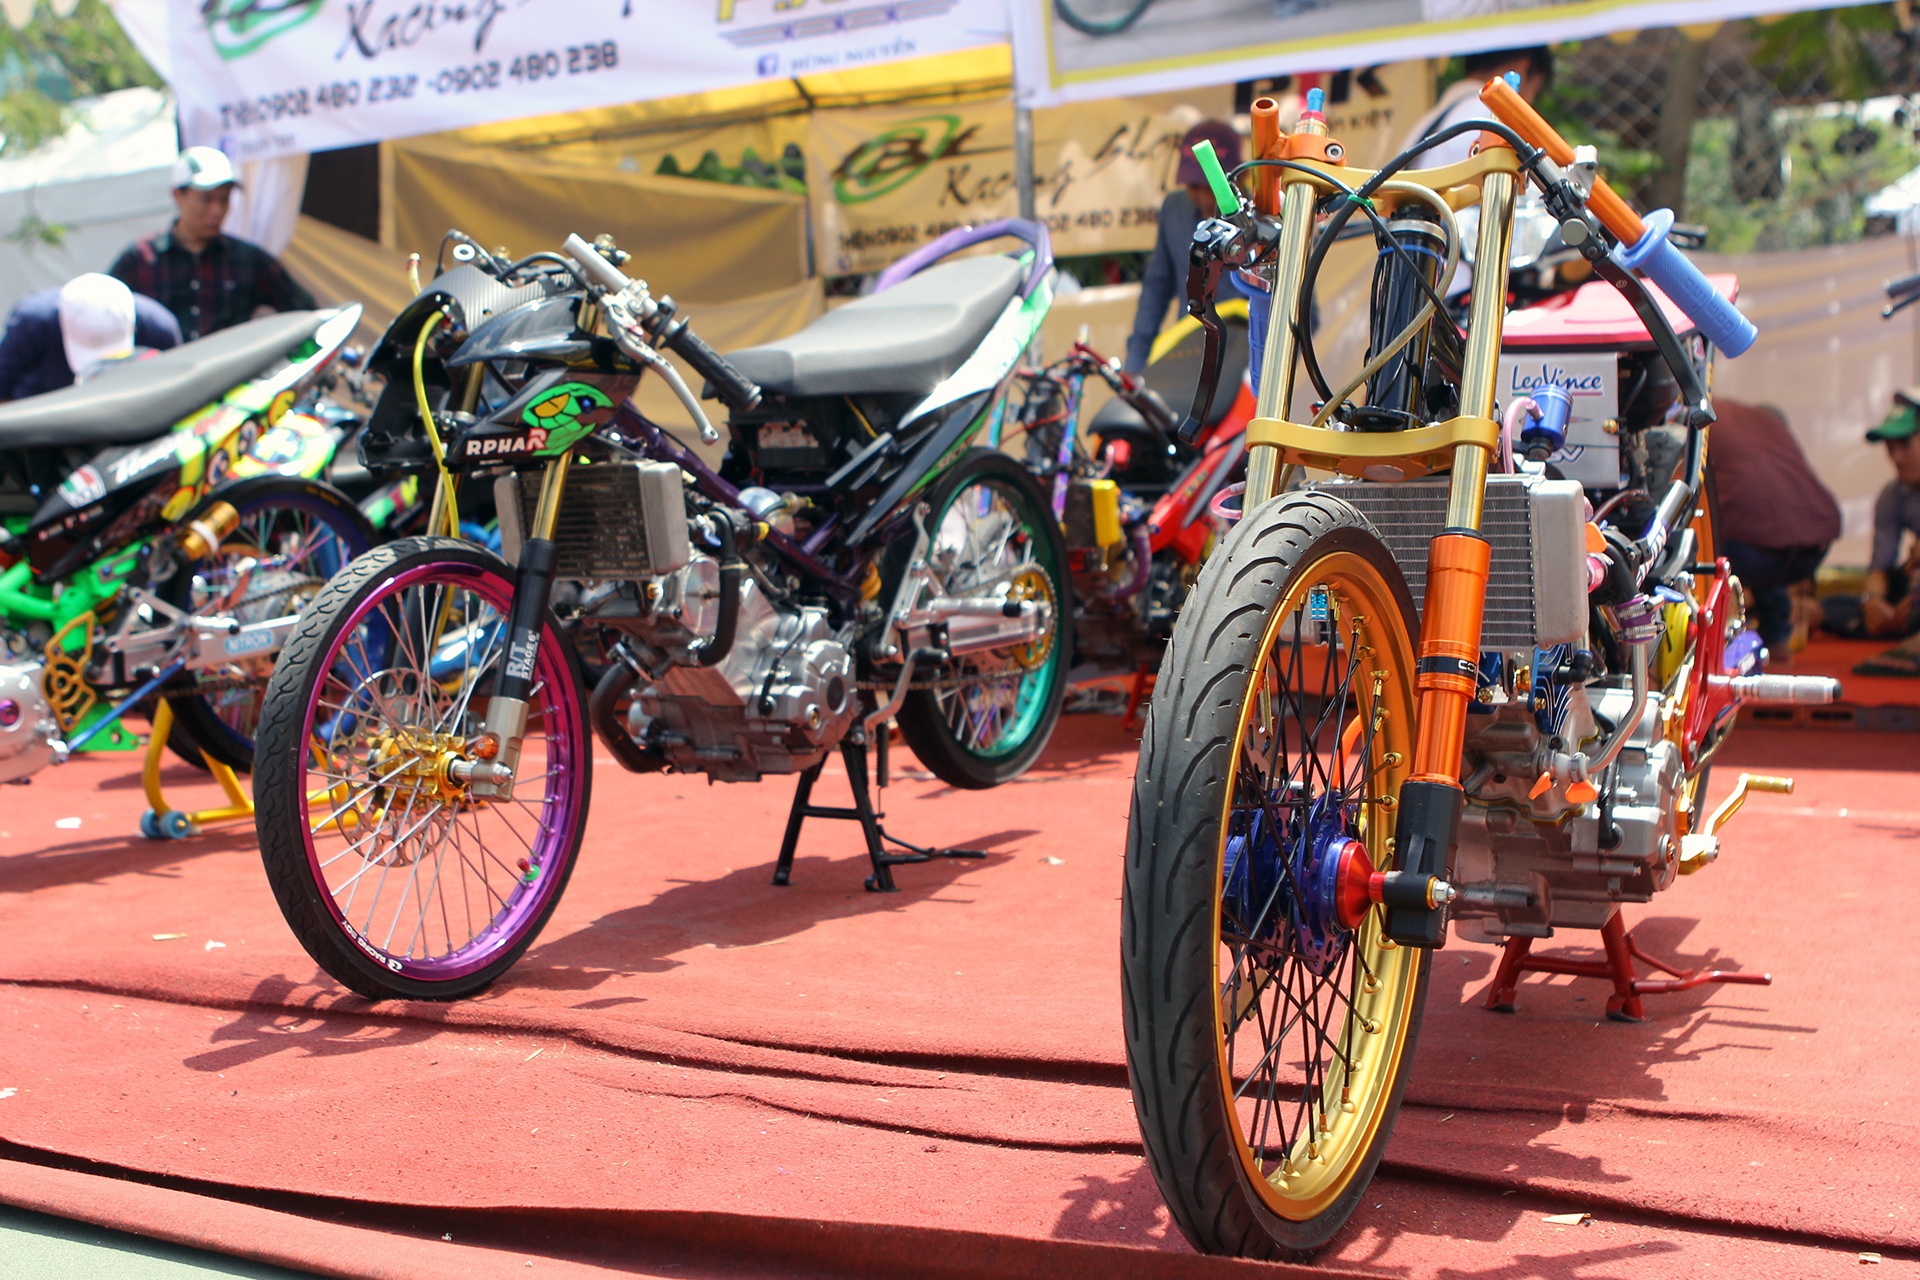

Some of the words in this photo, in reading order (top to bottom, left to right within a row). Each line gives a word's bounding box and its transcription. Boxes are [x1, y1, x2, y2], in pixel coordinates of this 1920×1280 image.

[509, 51, 560, 81] 480
[567, 39, 617, 74] 238
[1511, 363, 1603, 391] LeoVince
[466, 427, 549, 456] RPHAR
